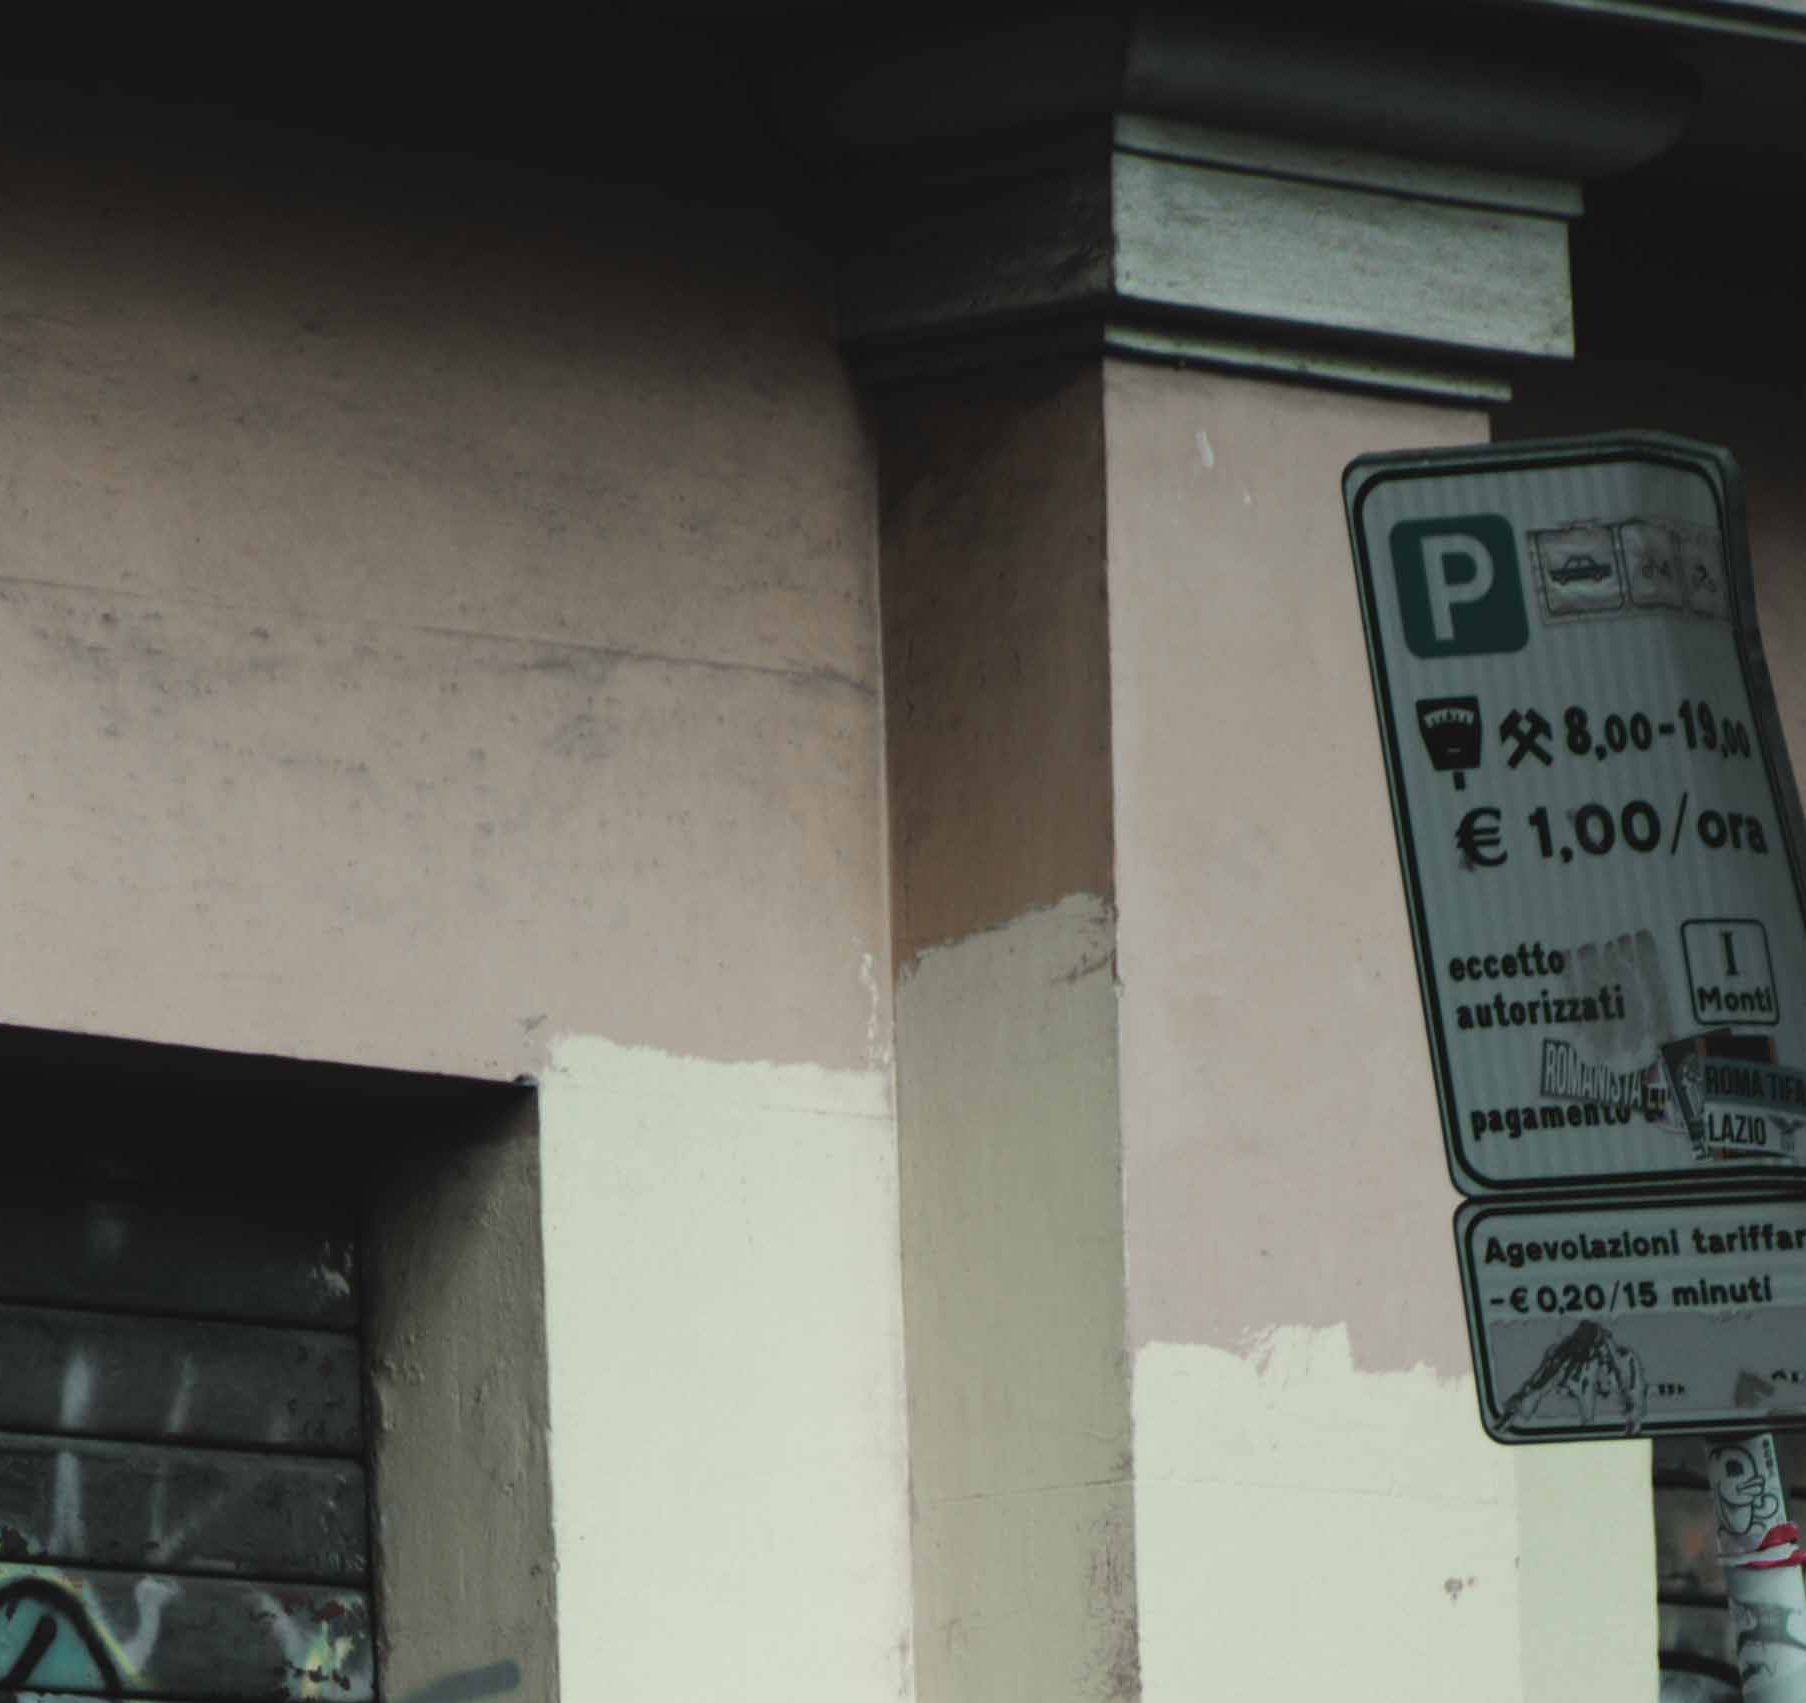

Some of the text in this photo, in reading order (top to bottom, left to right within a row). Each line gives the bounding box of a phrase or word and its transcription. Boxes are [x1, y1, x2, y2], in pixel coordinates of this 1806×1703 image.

[1420, 533, 1494, 643] P
[1455, 806, 1508, 868] €
[1449, 942, 1567, 981] eccetto
[1456, 984, 1626, 1030] autorizzati
[1697, 987, 1774, 1016] Monti
[1470, 1098, 1632, 1141] pagamento
[1708, 1112, 1767, 1146] LAZIO
[1484, 1228, 1681, 1268] Agevolazioni
[1671, 1274, 1773, 1306] minuti
